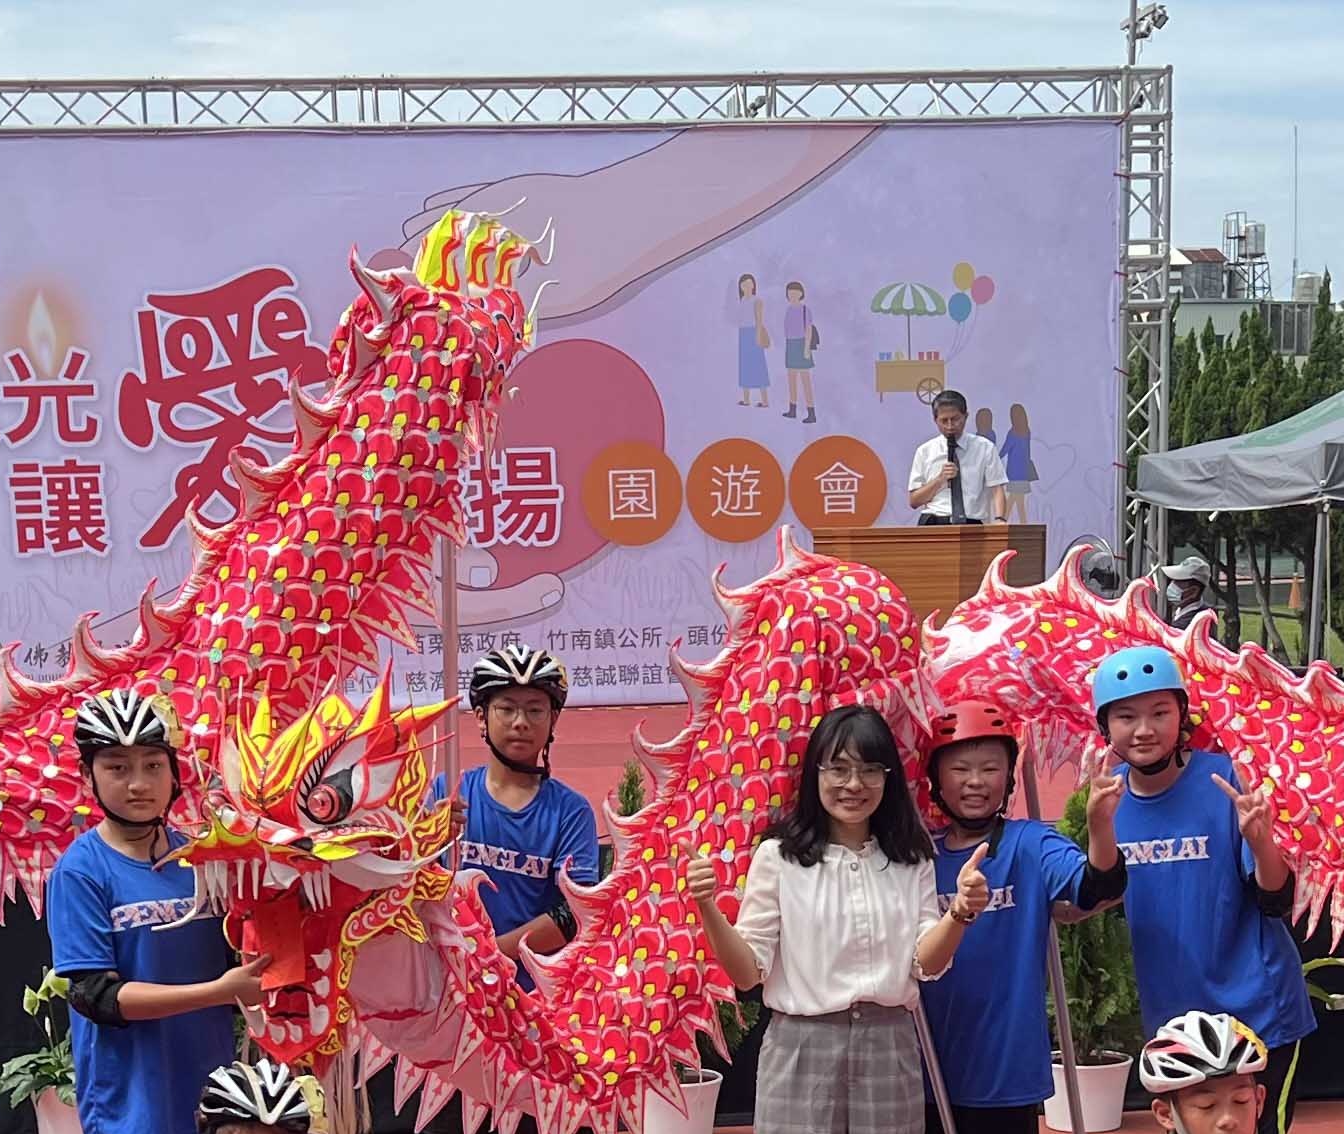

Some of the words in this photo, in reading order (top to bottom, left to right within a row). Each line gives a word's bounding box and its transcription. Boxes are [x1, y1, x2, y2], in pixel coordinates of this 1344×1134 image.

[7, 459, 108, 553] 讓
[470, 452, 561, 545] 揚
[609, 461, 864, 521] 園遊會
